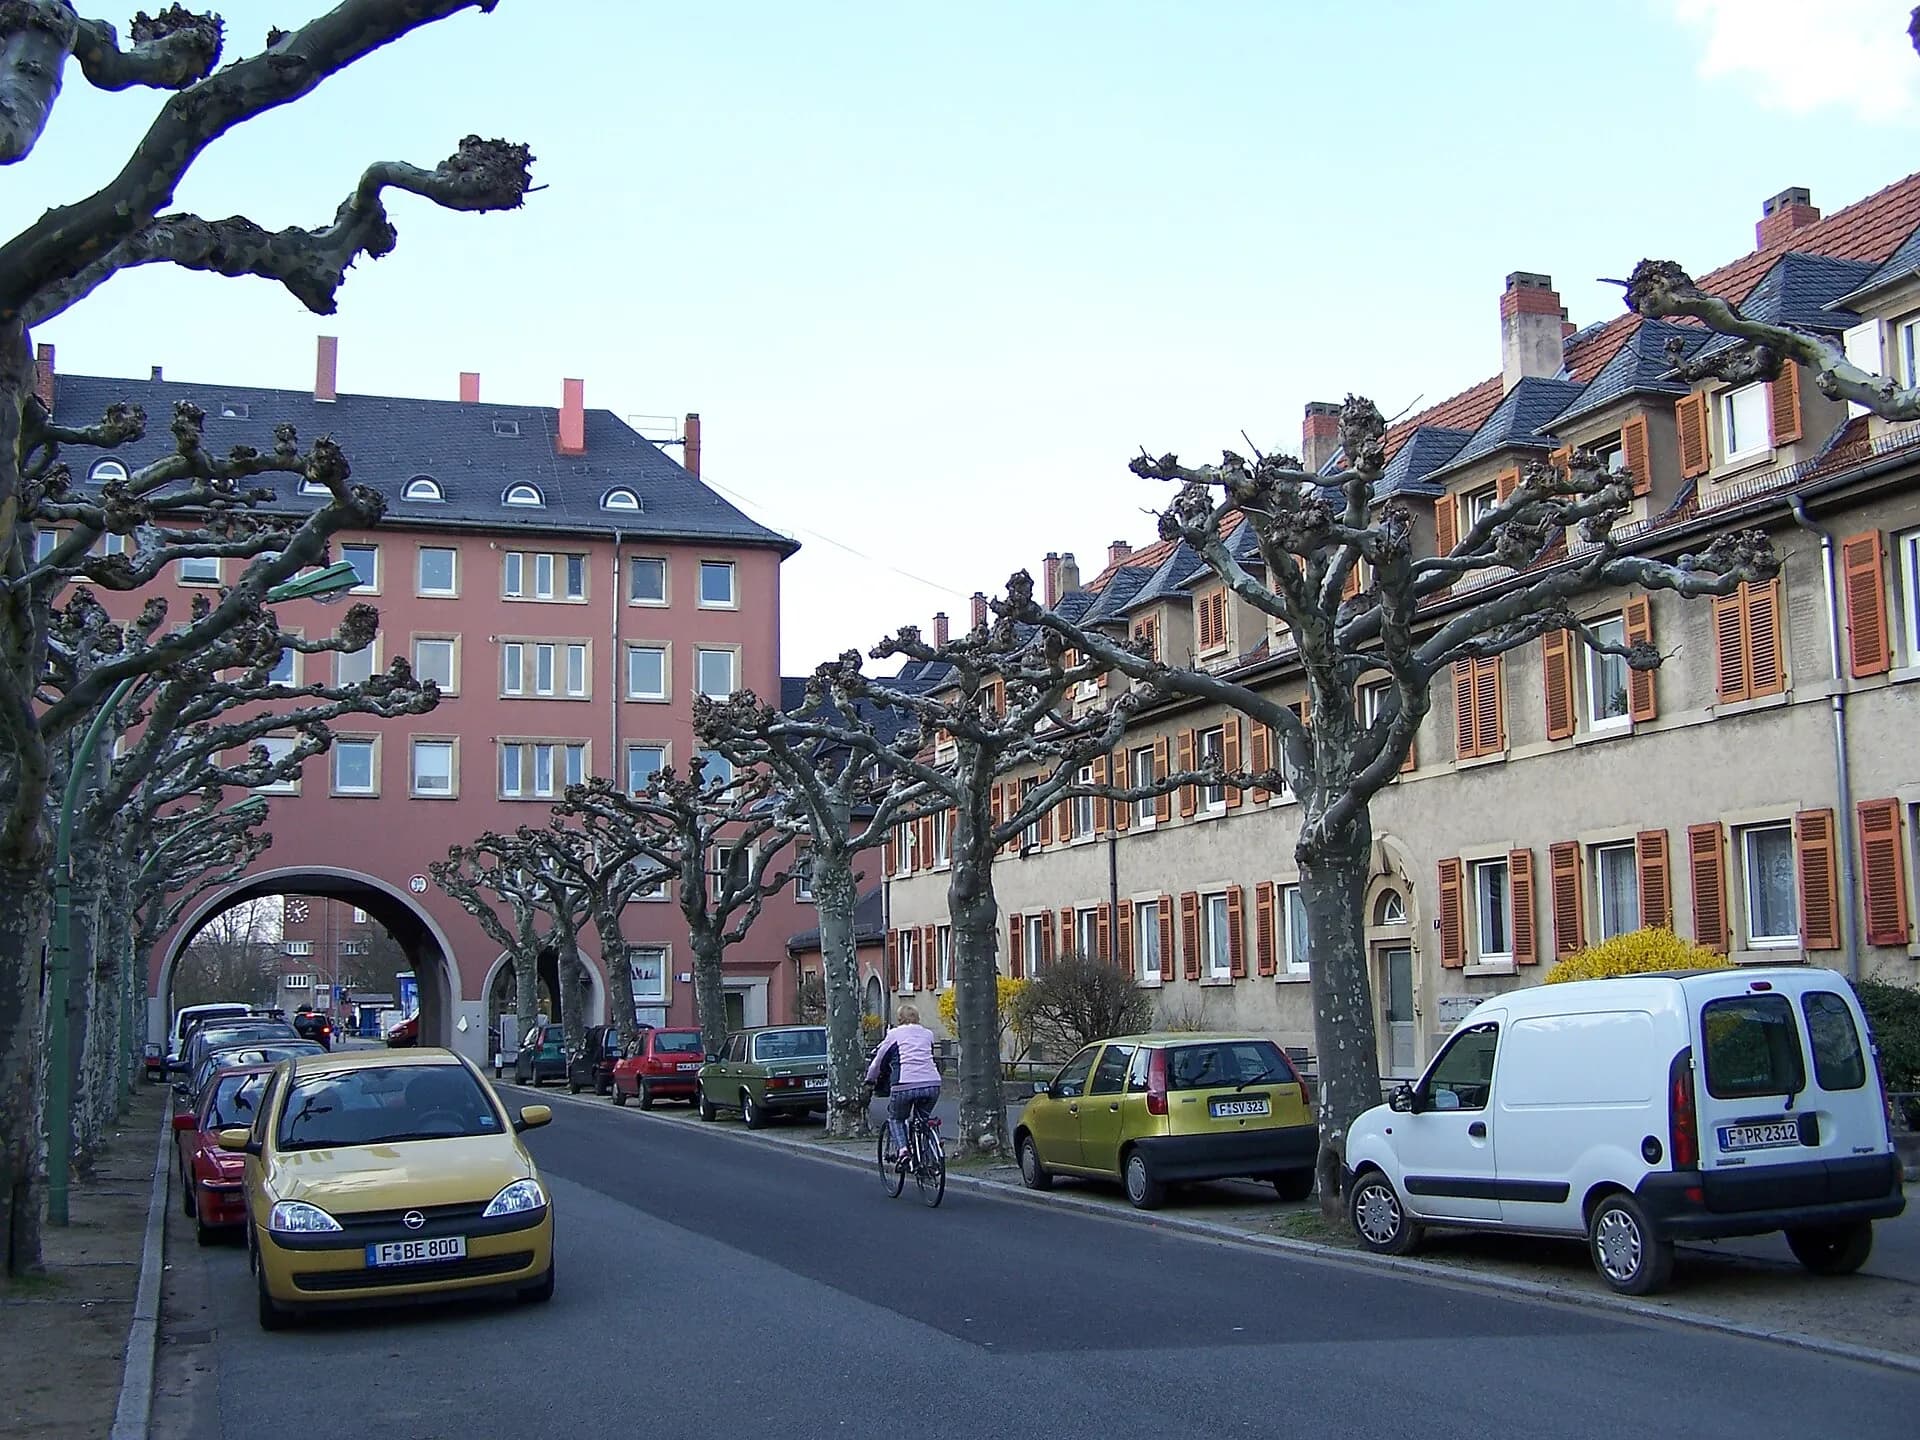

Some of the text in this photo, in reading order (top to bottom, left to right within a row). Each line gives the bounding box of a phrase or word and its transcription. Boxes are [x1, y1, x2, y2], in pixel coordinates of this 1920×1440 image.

[1232, 1103, 1245, 1113] SV
[1247, 1101, 1264, 1112] 323
[1745, 1127, 1763, 1143] PR
[1764, 1124, 1797, 1142] 2312
[404, 1242, 425, 1260] BE
[429, 1238, 459, 1257] 800
